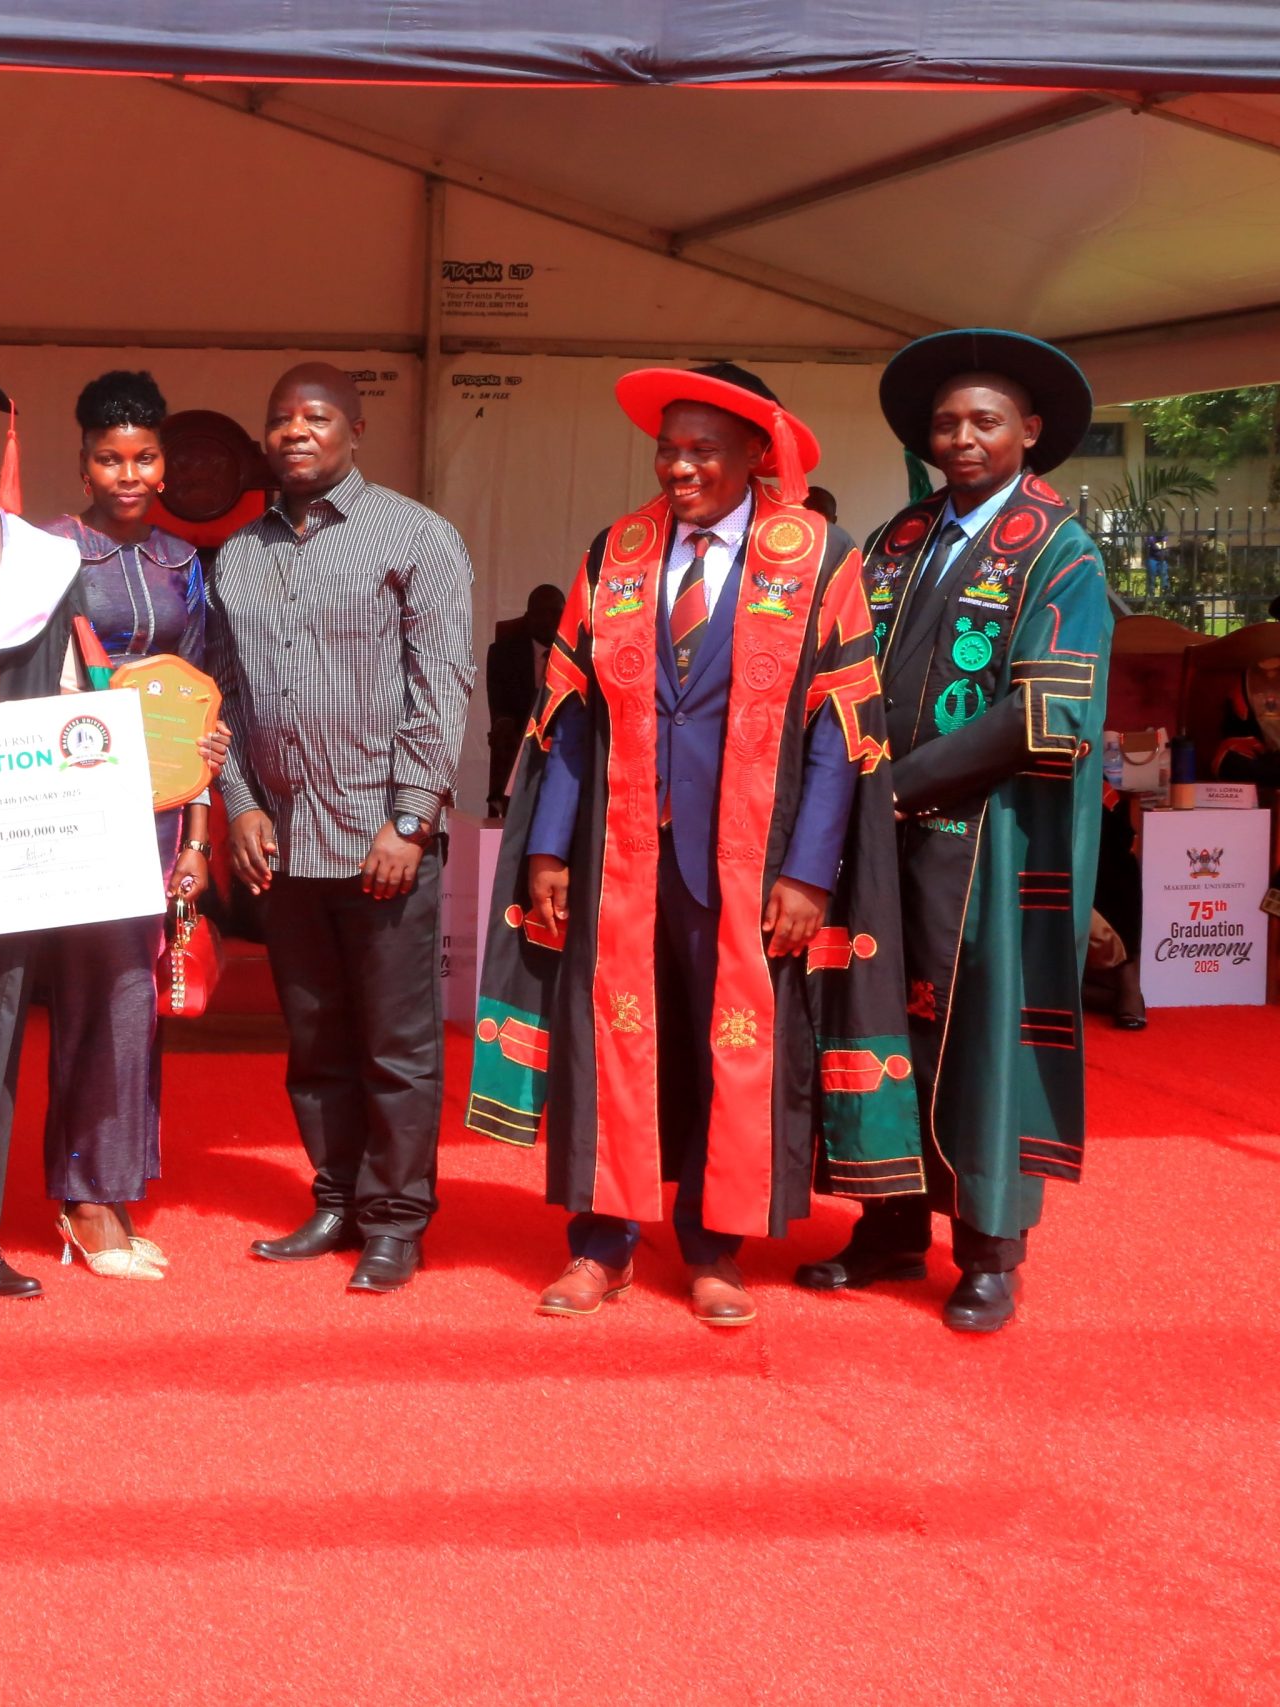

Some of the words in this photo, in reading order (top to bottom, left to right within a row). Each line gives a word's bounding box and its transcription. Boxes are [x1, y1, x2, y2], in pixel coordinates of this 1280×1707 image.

[509, 264, 533, 280] LTD
[446, 292, 463, 300] Your
[466, 291, 493, 300] Events
[494, 292, 524, 300] Partner
[452, 374, 501, 387] FOTOGENIX
[476, 406, 484, 419] A
[19, 792, 58, 805] JANUARY
[0, 825, 56, 842] 1,000,000
[1204, 882, 1245, 890] UNIVERSITY
[1188, 900, 1227, 921] 75th
[1171, 921, 1244, 938] Graduation
[1155, 938, 1253, 965] Ceremony
[1194, 960, 1219, 973] 2025
